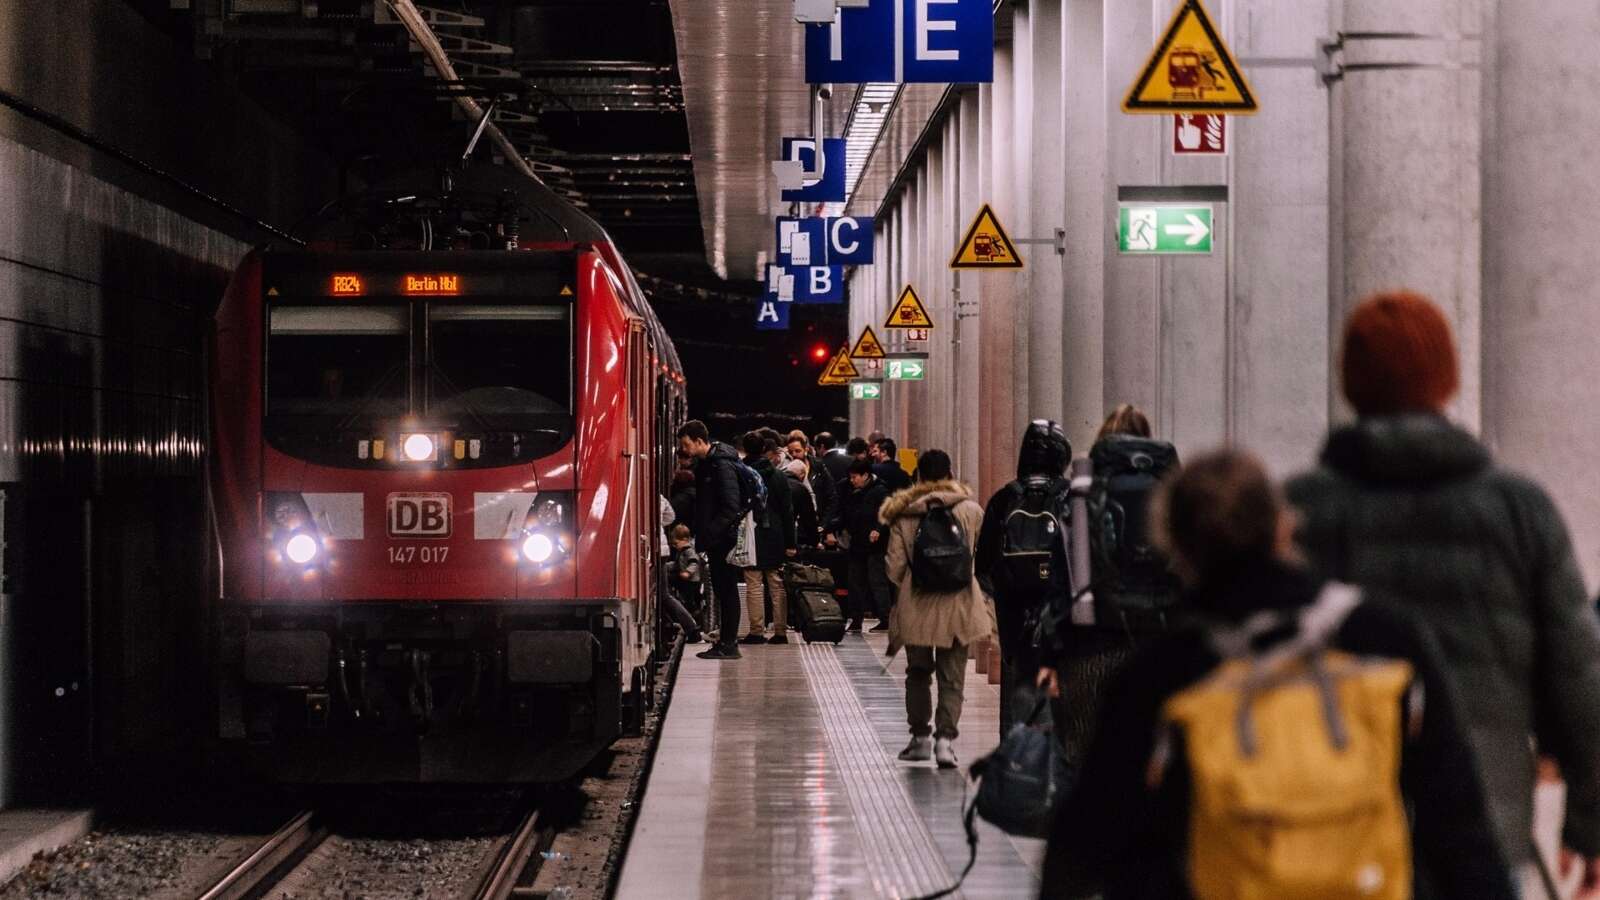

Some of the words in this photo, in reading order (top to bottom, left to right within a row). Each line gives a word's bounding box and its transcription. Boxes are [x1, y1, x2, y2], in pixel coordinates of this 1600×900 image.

[915, 0, 960, 61] E
[791, 140, 826, 187] D
[831, 217, 860, 255] C
[333, 275, 361, 293] RB24
[407, 275, 438, 292] Berlin
[810, 266, 832, 294] B
[757, 301, 779, 322] A
[396, 500, 444, 531] DB
[387, 546, 416, 564] 147
[420, 546, 449, 563] 017
